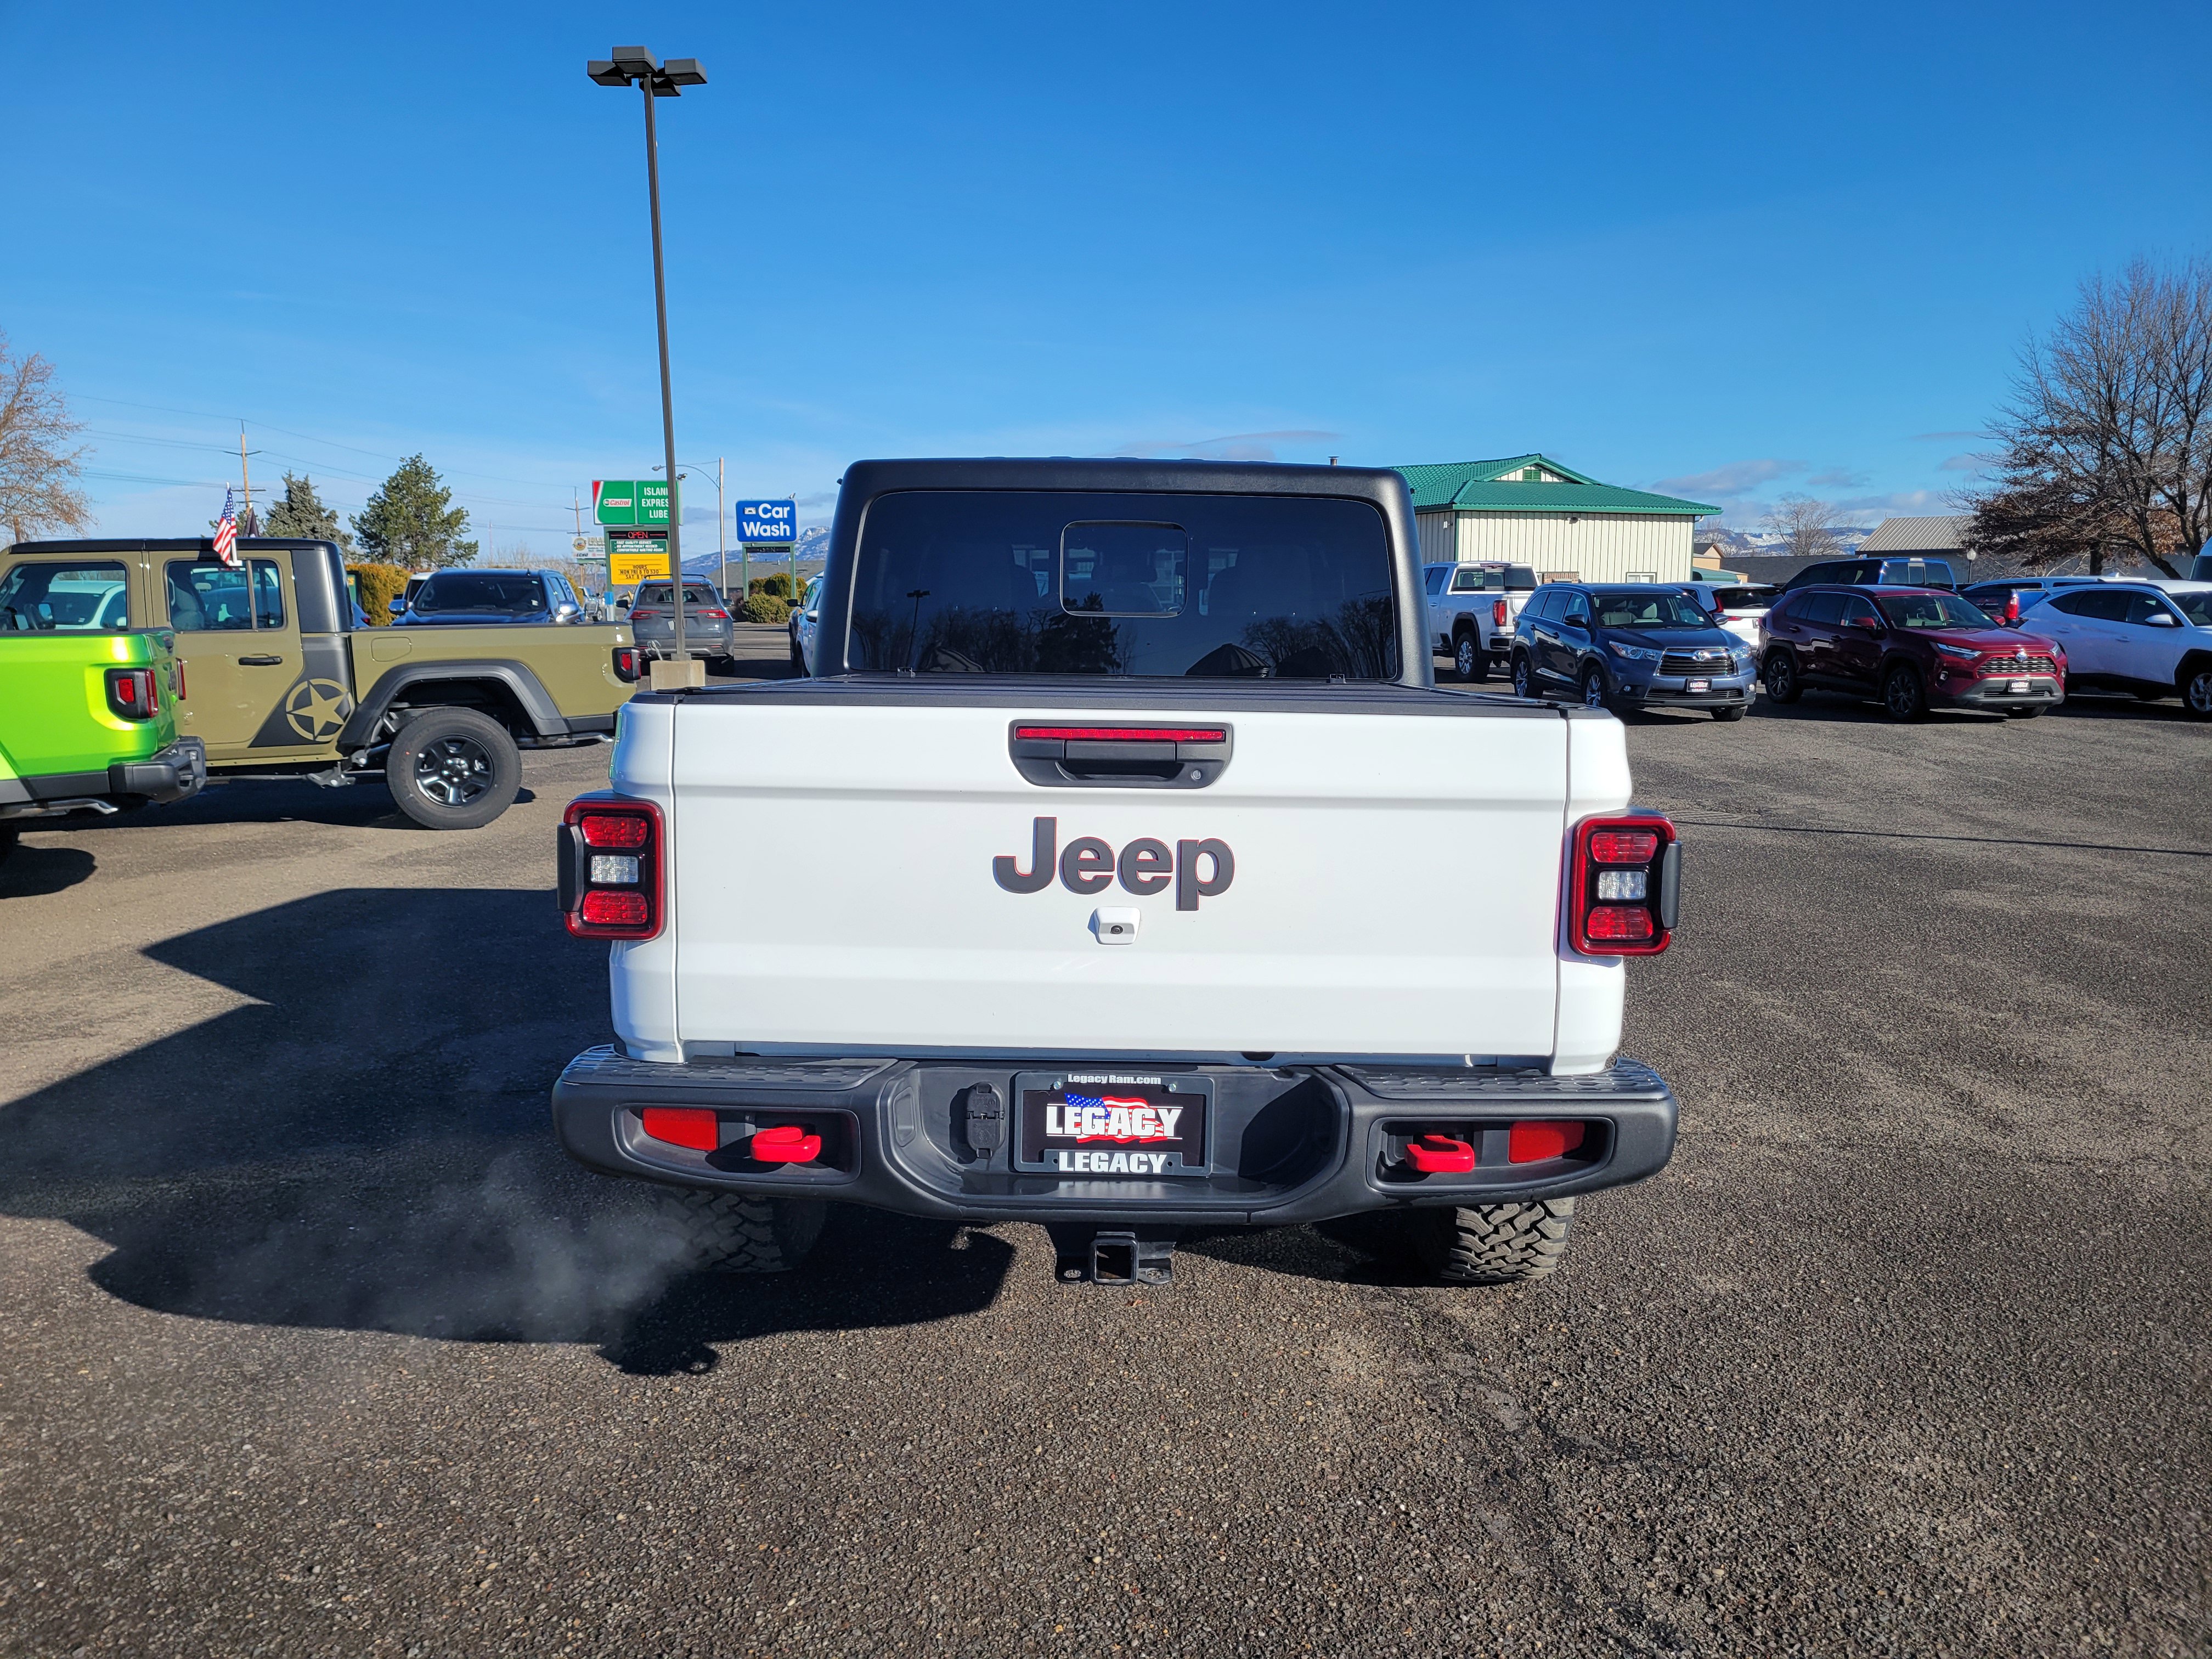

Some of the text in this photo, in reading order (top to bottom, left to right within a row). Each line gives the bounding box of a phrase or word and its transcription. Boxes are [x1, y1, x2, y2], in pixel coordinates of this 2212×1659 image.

[641, 498, 669, 507] EXPRES
[758, 503, 790, 518] Car
[649, 509, 669, 518] LUBE
[742, 521, 790, 537] Wash
[992, 817, 1235, 911] Jeep
[1046, 1105, 1182, 1137] LEGACY
[1058, 1152, 1167, 1174] LEGACY
